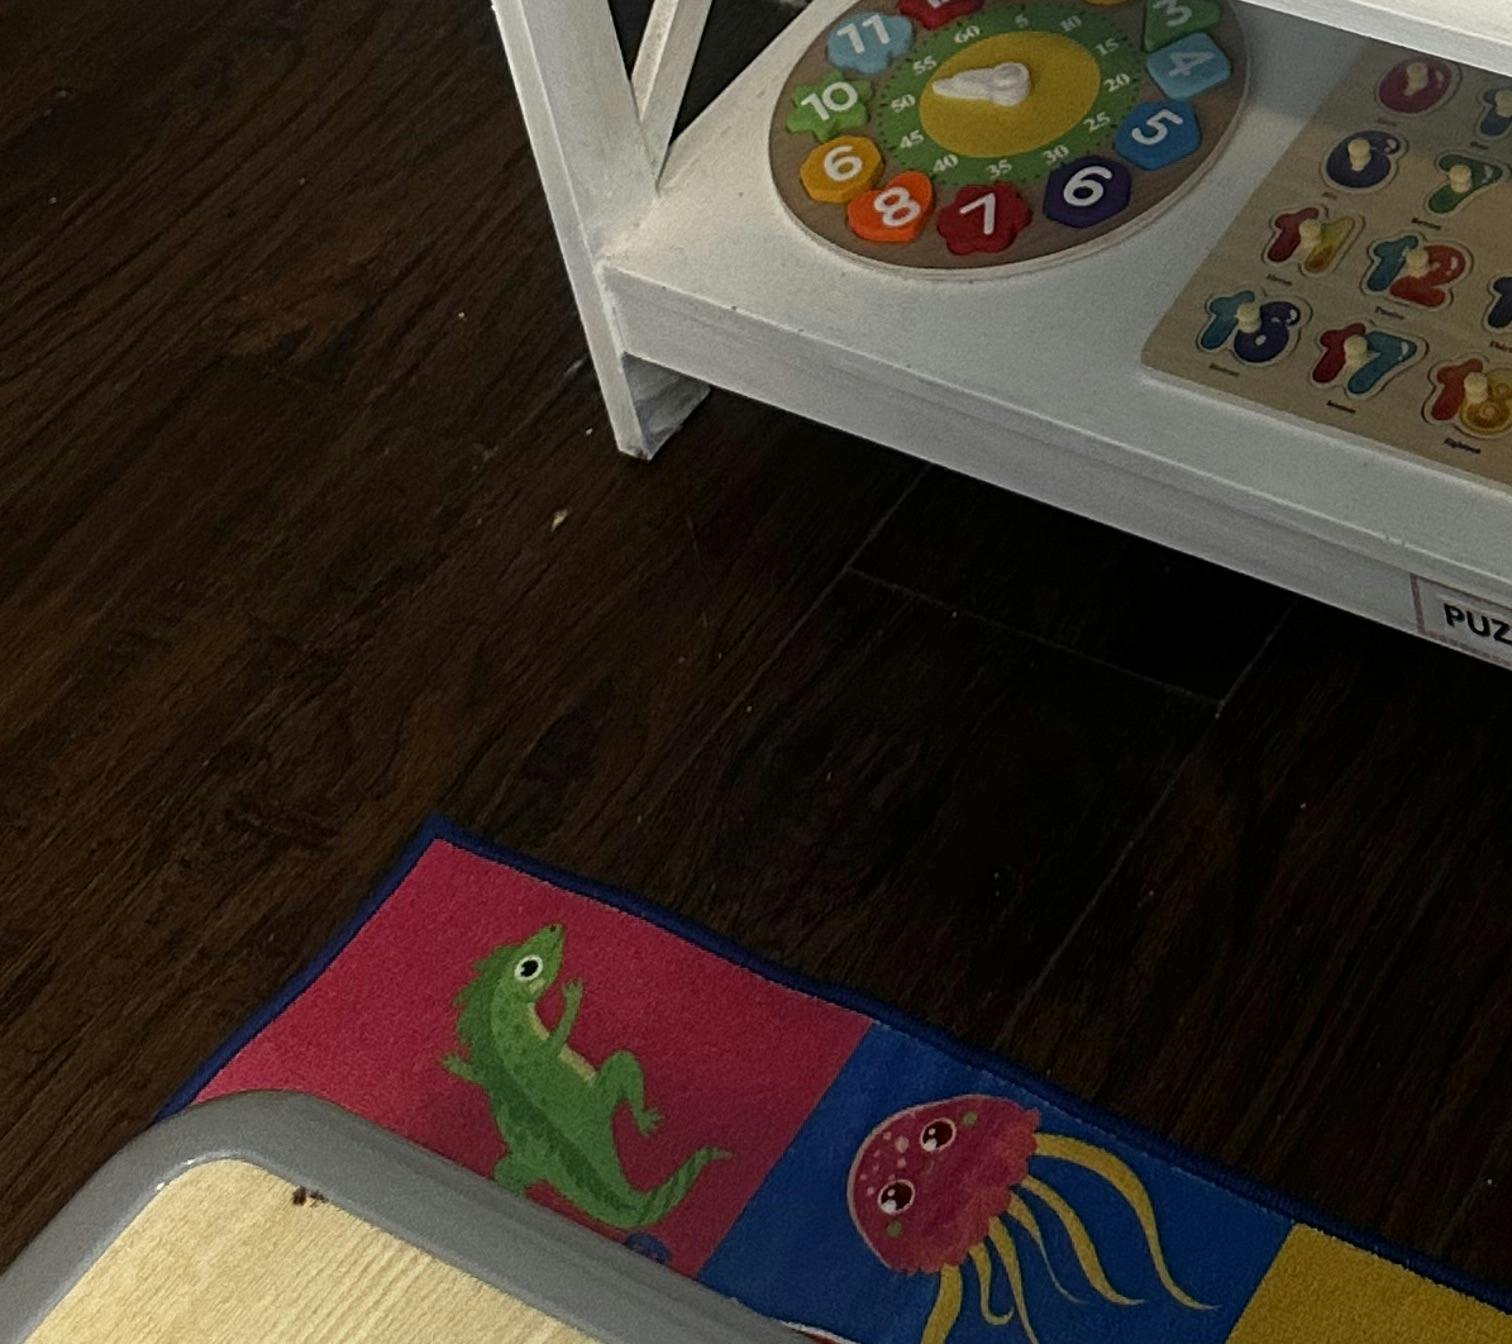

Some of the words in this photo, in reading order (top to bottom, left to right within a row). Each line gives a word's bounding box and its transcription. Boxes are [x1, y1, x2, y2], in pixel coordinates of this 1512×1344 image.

[837, 14, 890, 55] 11
[953, 25, 981, 44] 60
[1095, 37, 1119, 56] 15
[912, 55, 937, 74] 55
[1167, 49, 1215, 79] 4
[1104, 72, 1131, 92] 20
[801, 81, 859, 121] 10
[1083, 112, 1111, 132] 25
[1131, 108, 1184, 146] 5
[900, 129, 925, 149] 45
[1042, 145, 1069, 163] 30
[932, 154, 959, 172] 40
[986, 159, 1013, 176] 35
[1326, 130, 1400, 188] 6
[1428, 154, 1503, 214] 7
[1063, 165, 1114, 208] 6
[873, 186, 922, 227] 8
[959, 193, 997, 235] 7
[1367, 235, 1466, 306] 12
[1200, 290, 1300, 362] 16
[1313, 322, 1417, 394] 17
